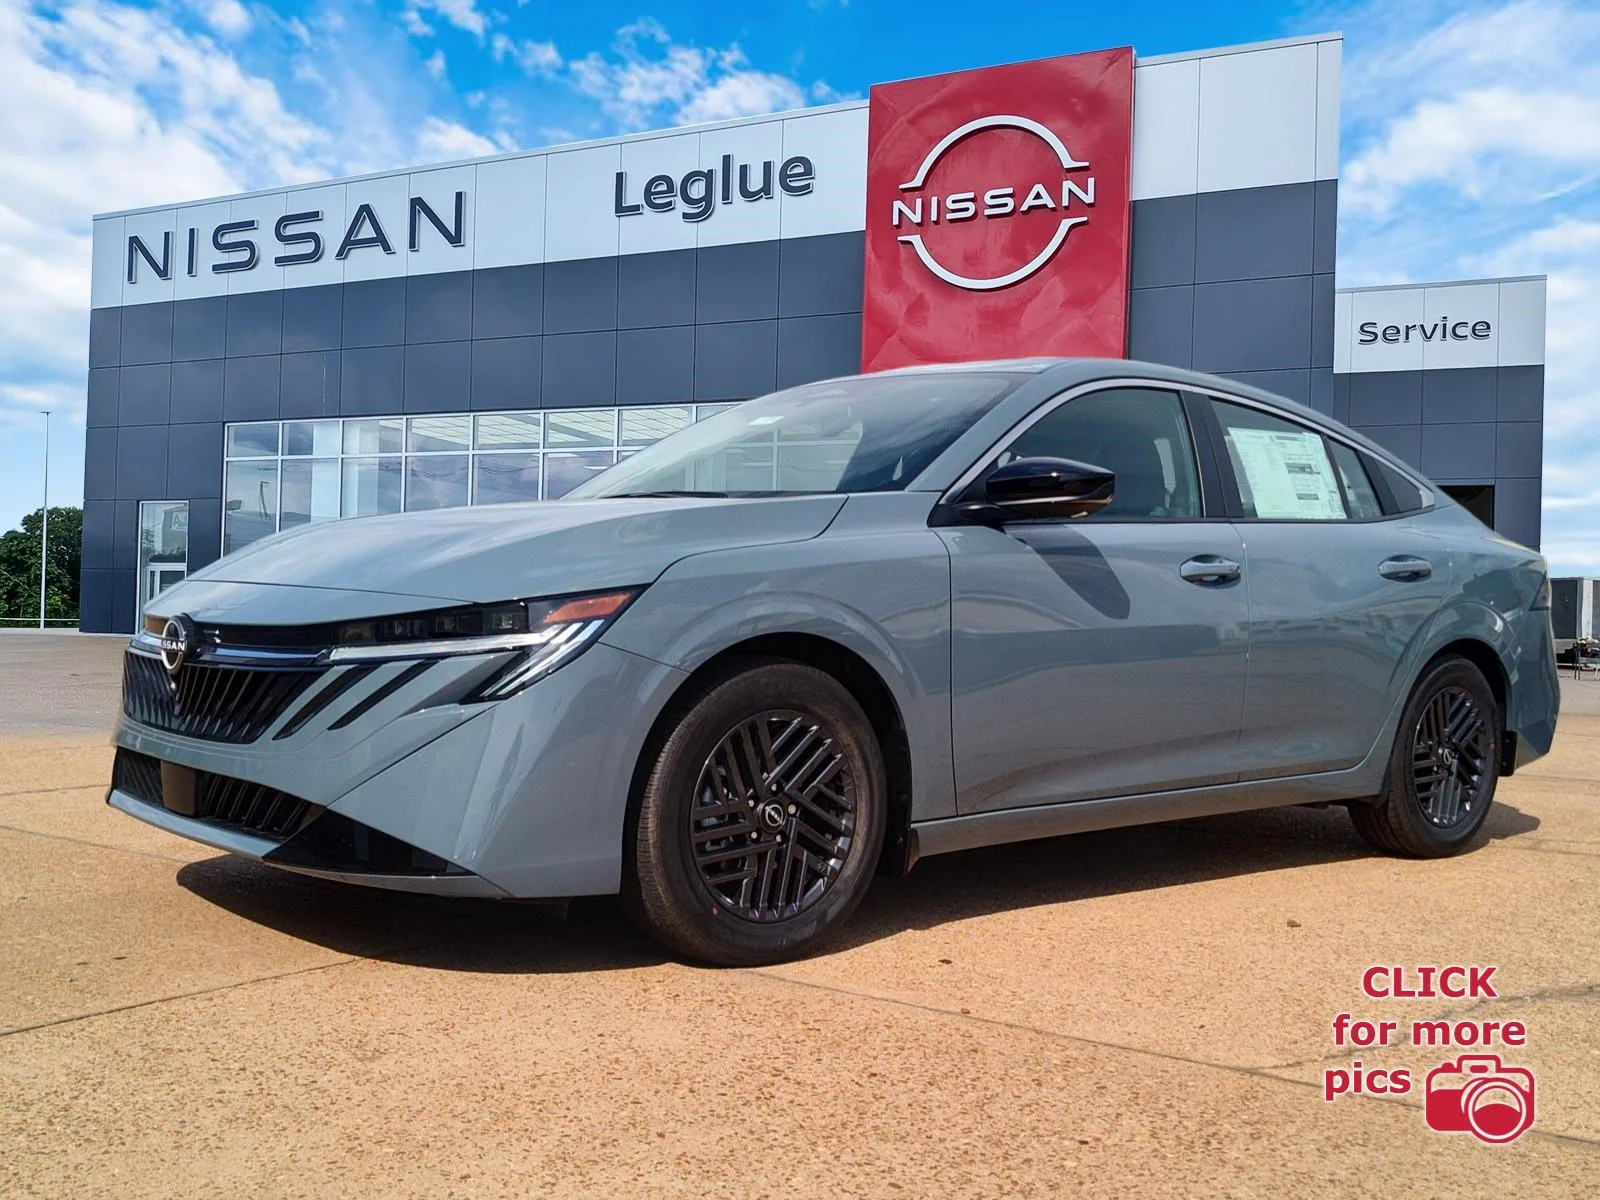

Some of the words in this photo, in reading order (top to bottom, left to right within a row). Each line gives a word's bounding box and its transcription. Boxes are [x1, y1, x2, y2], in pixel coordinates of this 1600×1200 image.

[615, 154, 815, 221] Leglue
[892, 176, 1096, 226] NISSAN
[126, 190, 466, 284] NISSAN
[1358, 315, 1492, 345] Service
